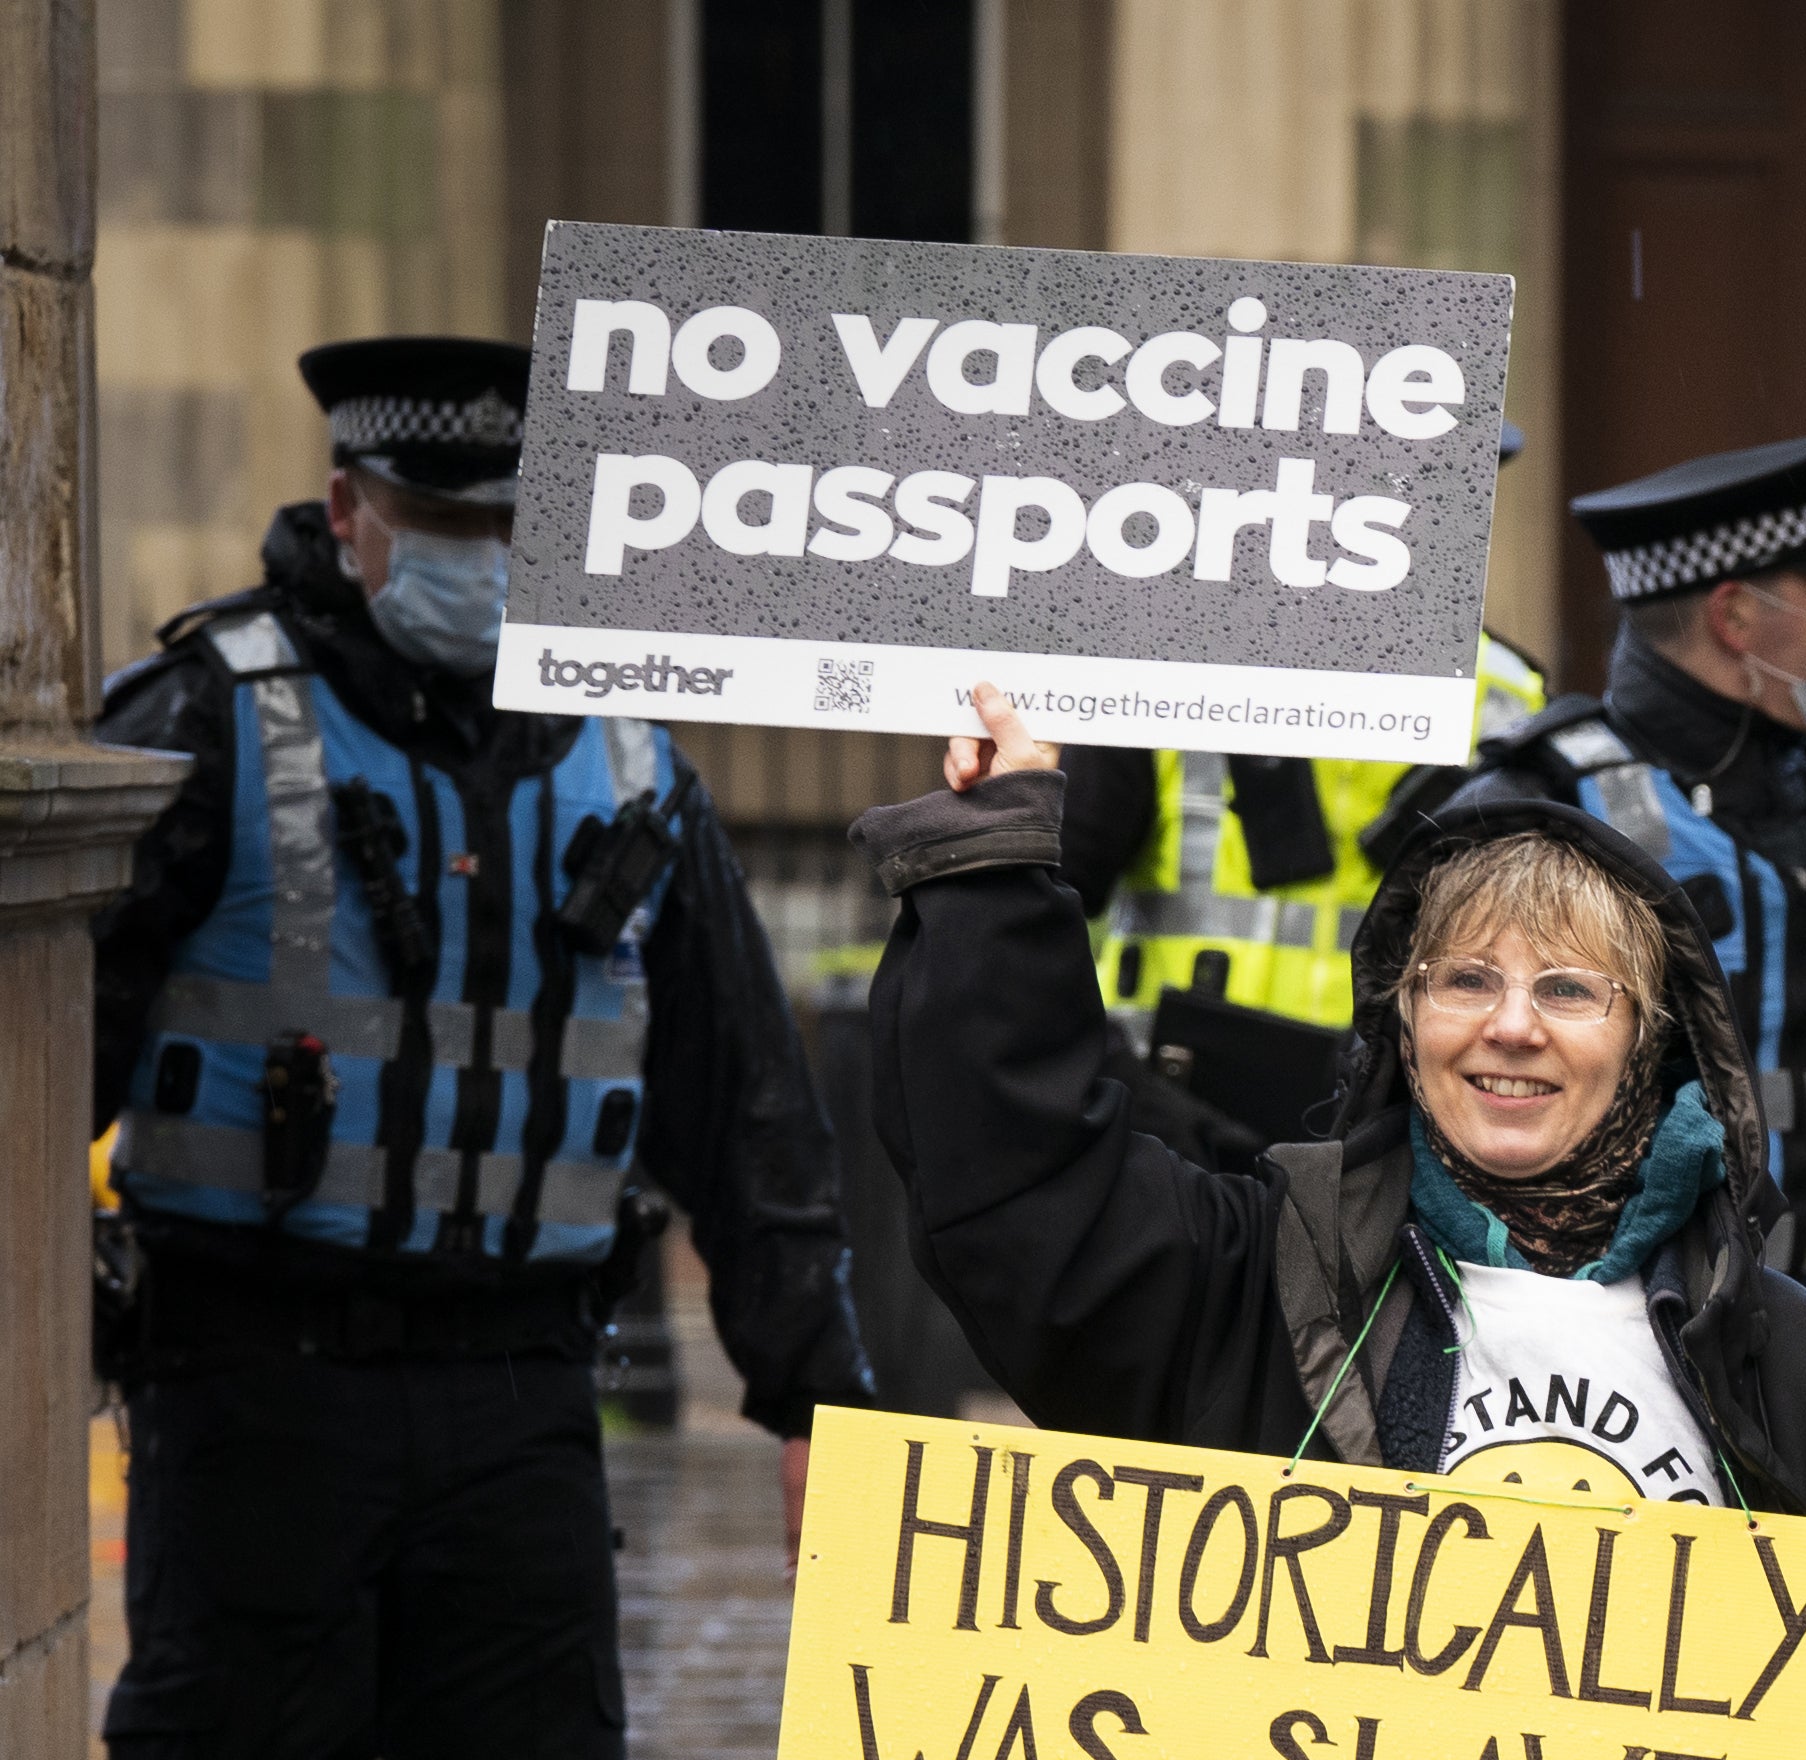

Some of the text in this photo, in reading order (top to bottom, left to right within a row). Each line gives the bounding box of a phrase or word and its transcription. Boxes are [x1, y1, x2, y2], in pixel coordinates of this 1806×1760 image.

[567, 299, 1465, 440] no vaccine
[585, 454, 1412, 597] passports
[538, 648, 734, 698] together
[954, 688, 1432, 741] ww.togetherdeclaration.org
